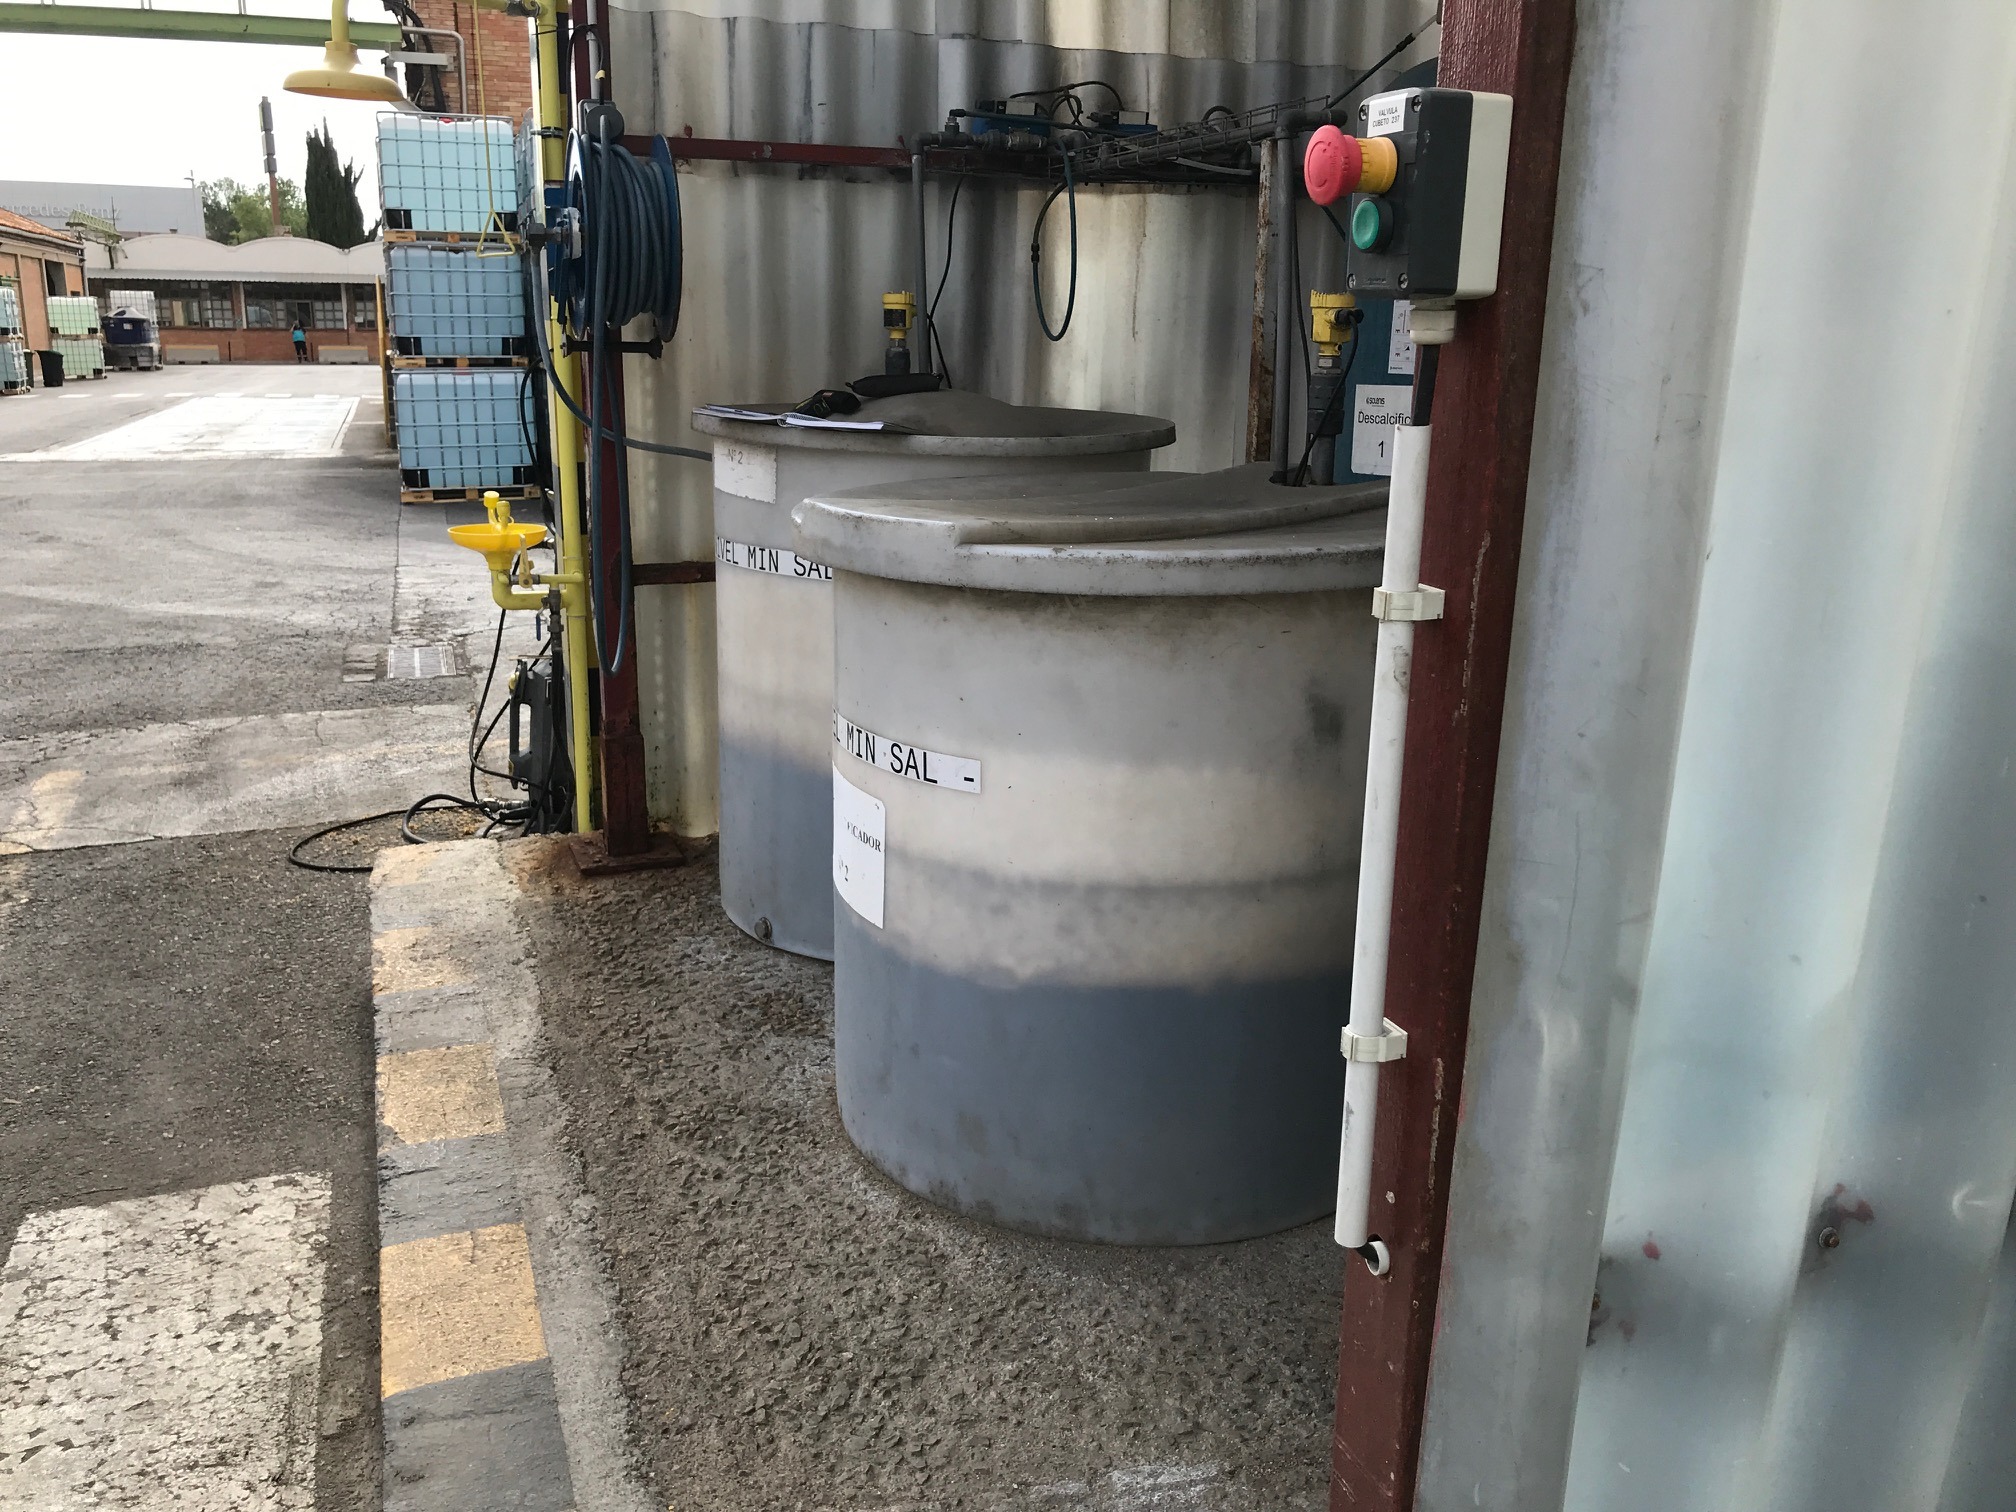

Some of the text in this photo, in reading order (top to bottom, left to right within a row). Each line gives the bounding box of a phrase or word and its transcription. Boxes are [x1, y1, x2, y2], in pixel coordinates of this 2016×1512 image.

[1379, 107, 1398, 116] VALVULA
[1373, 118, 1389, 127] CUBETO
[1378, 440, 1384, 458] 1
[747, 545, 779, 573] MIN
[793, 554, 833, 580] SAL
[846, 722, 876, 764] MIN
[890, 742, 938, 784] SAL
